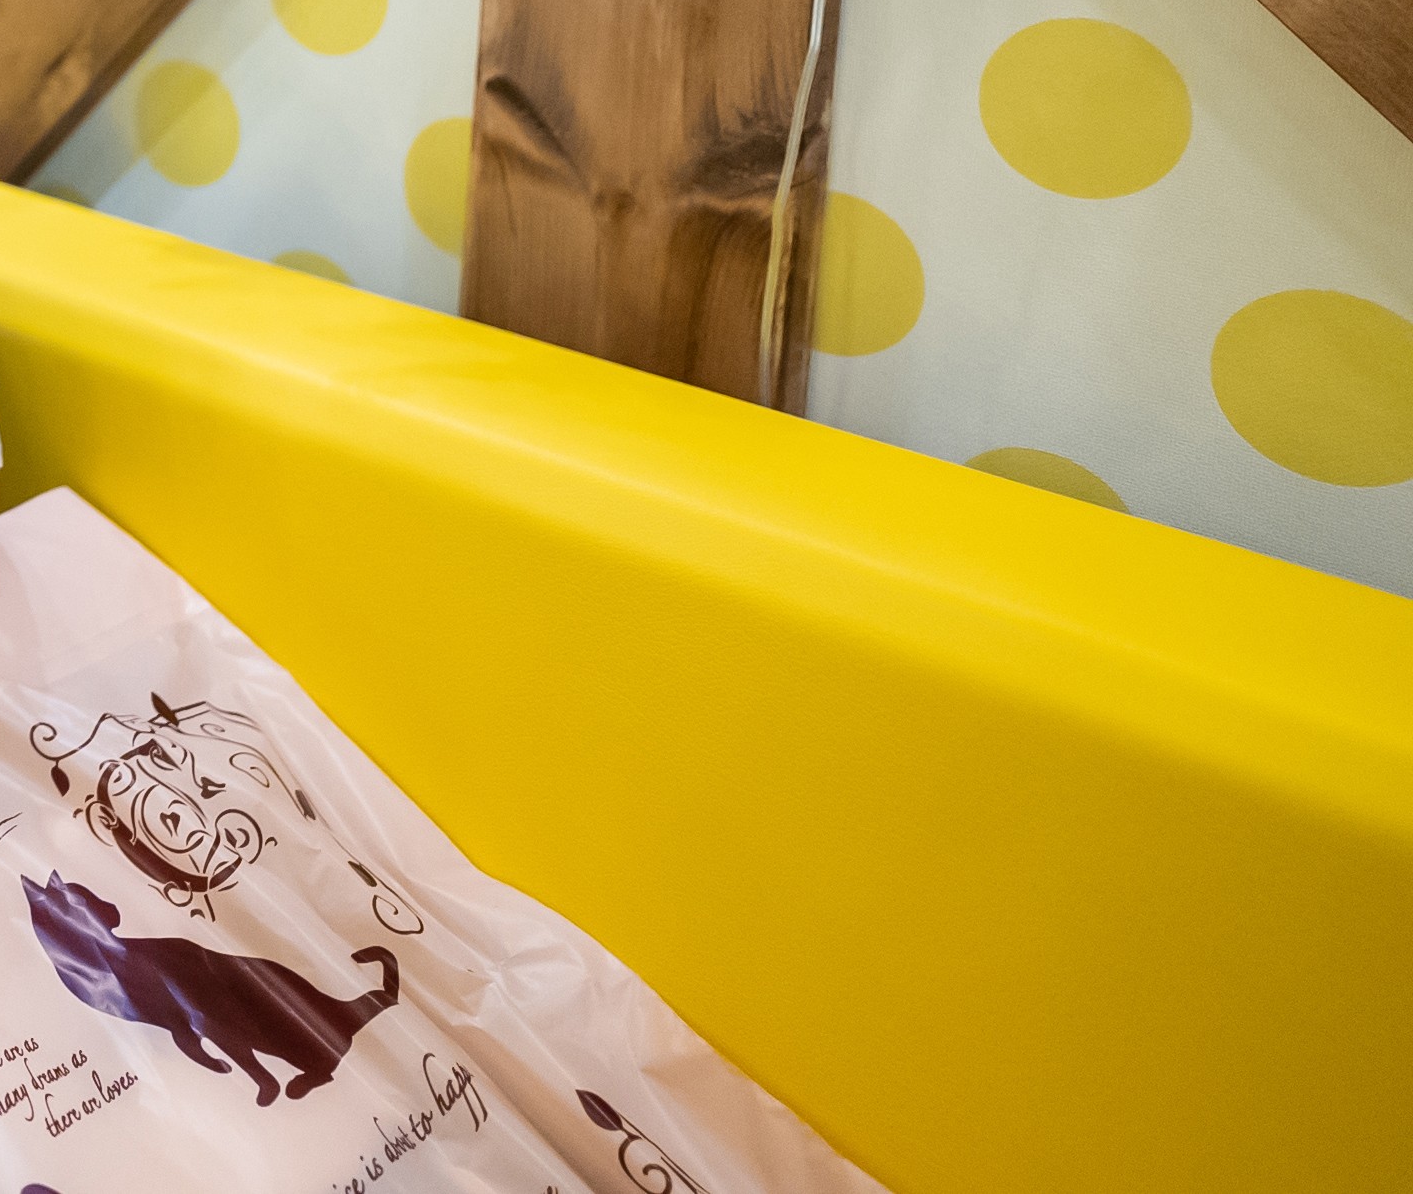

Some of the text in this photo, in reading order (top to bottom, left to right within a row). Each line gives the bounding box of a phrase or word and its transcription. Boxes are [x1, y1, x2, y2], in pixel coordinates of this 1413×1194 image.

[4, 1045, 24, 1062] are
[24, 1037, 40, 1053] as
[23, 1057, 71, 1091] dreams
[71, 1049, 88, 1069] as
[44, 1070, 139, 1138] there are loves.
[359, 1155, 384, 1182] is
[408, 1113, 433, 1142] to
